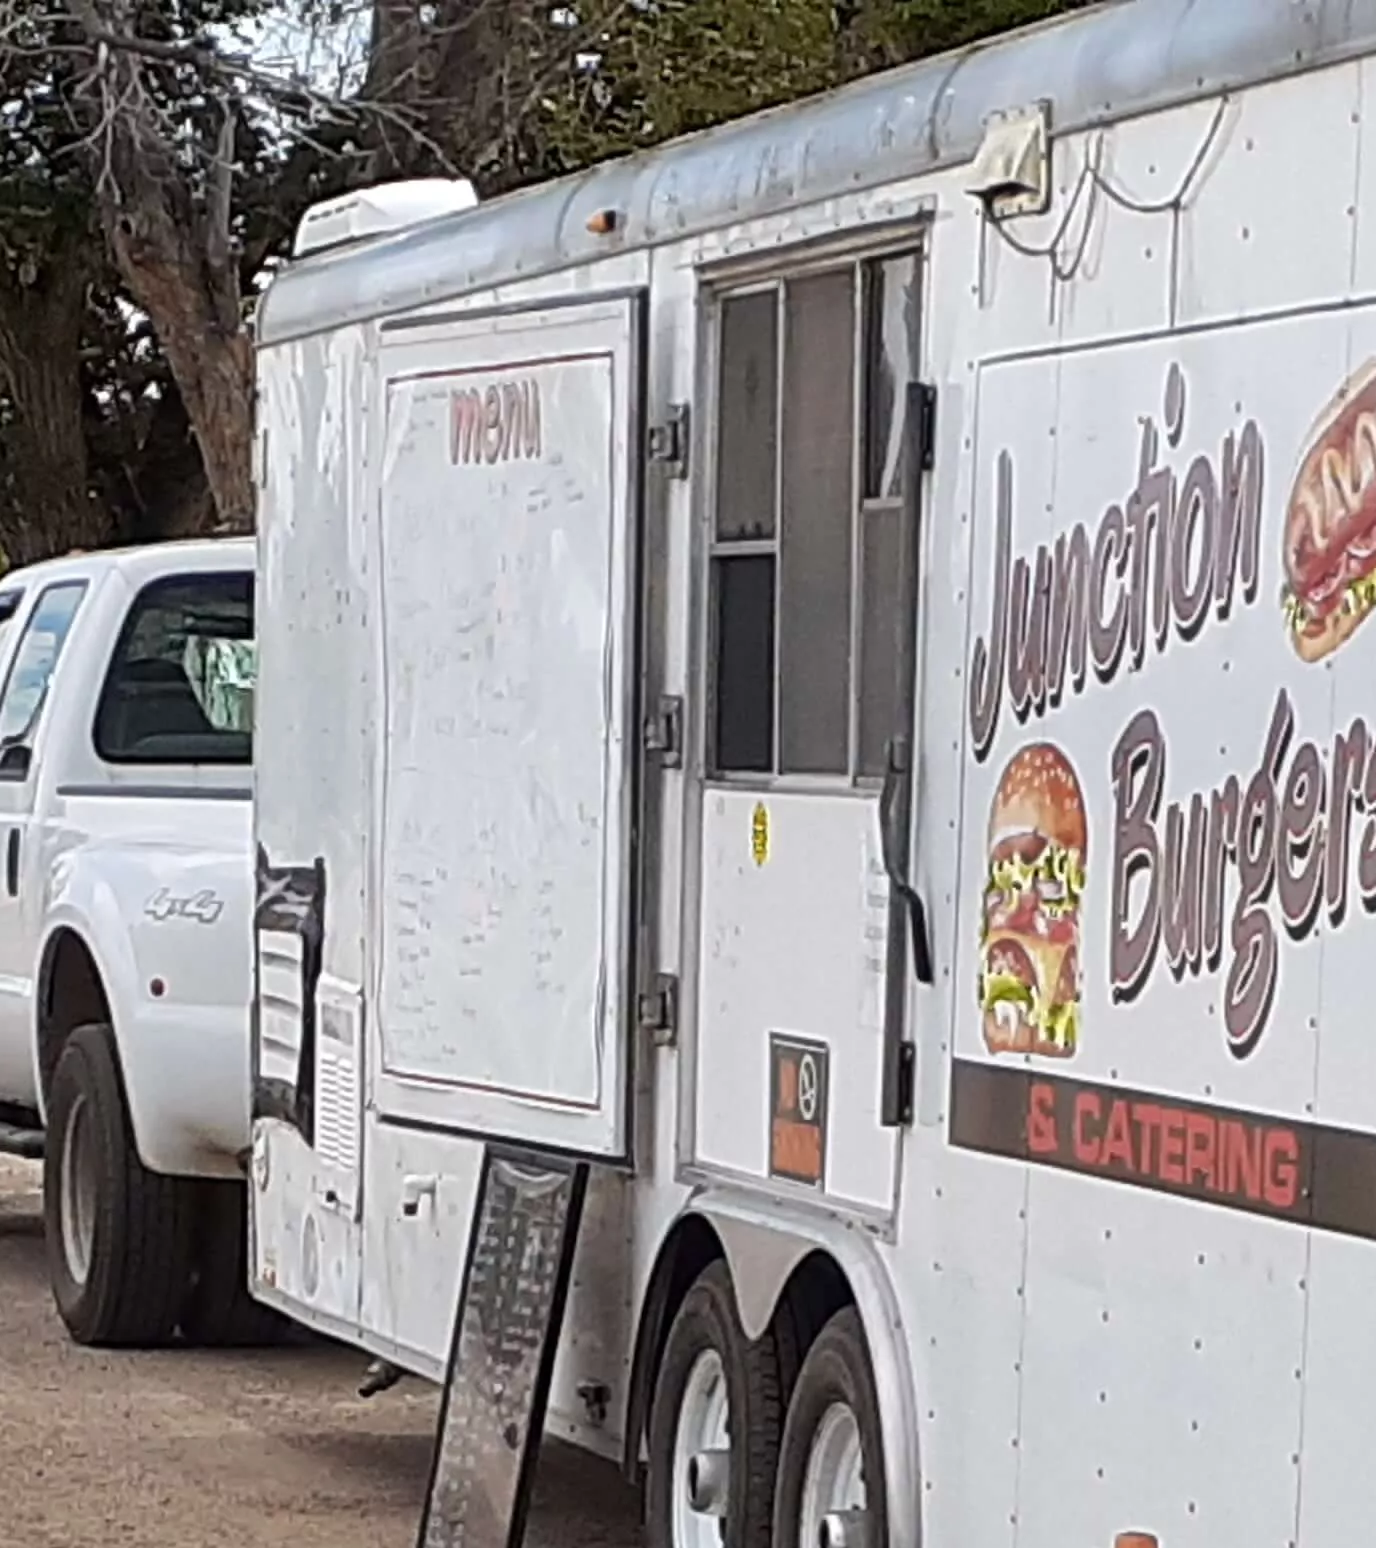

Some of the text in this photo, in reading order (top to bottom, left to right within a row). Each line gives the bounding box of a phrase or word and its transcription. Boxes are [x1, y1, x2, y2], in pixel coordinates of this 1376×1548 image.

[450, 377, 542, 466] menu
[970, 362, 1264, 763] Junction
[1027, 1082, 1299, 1208] & CATERING
